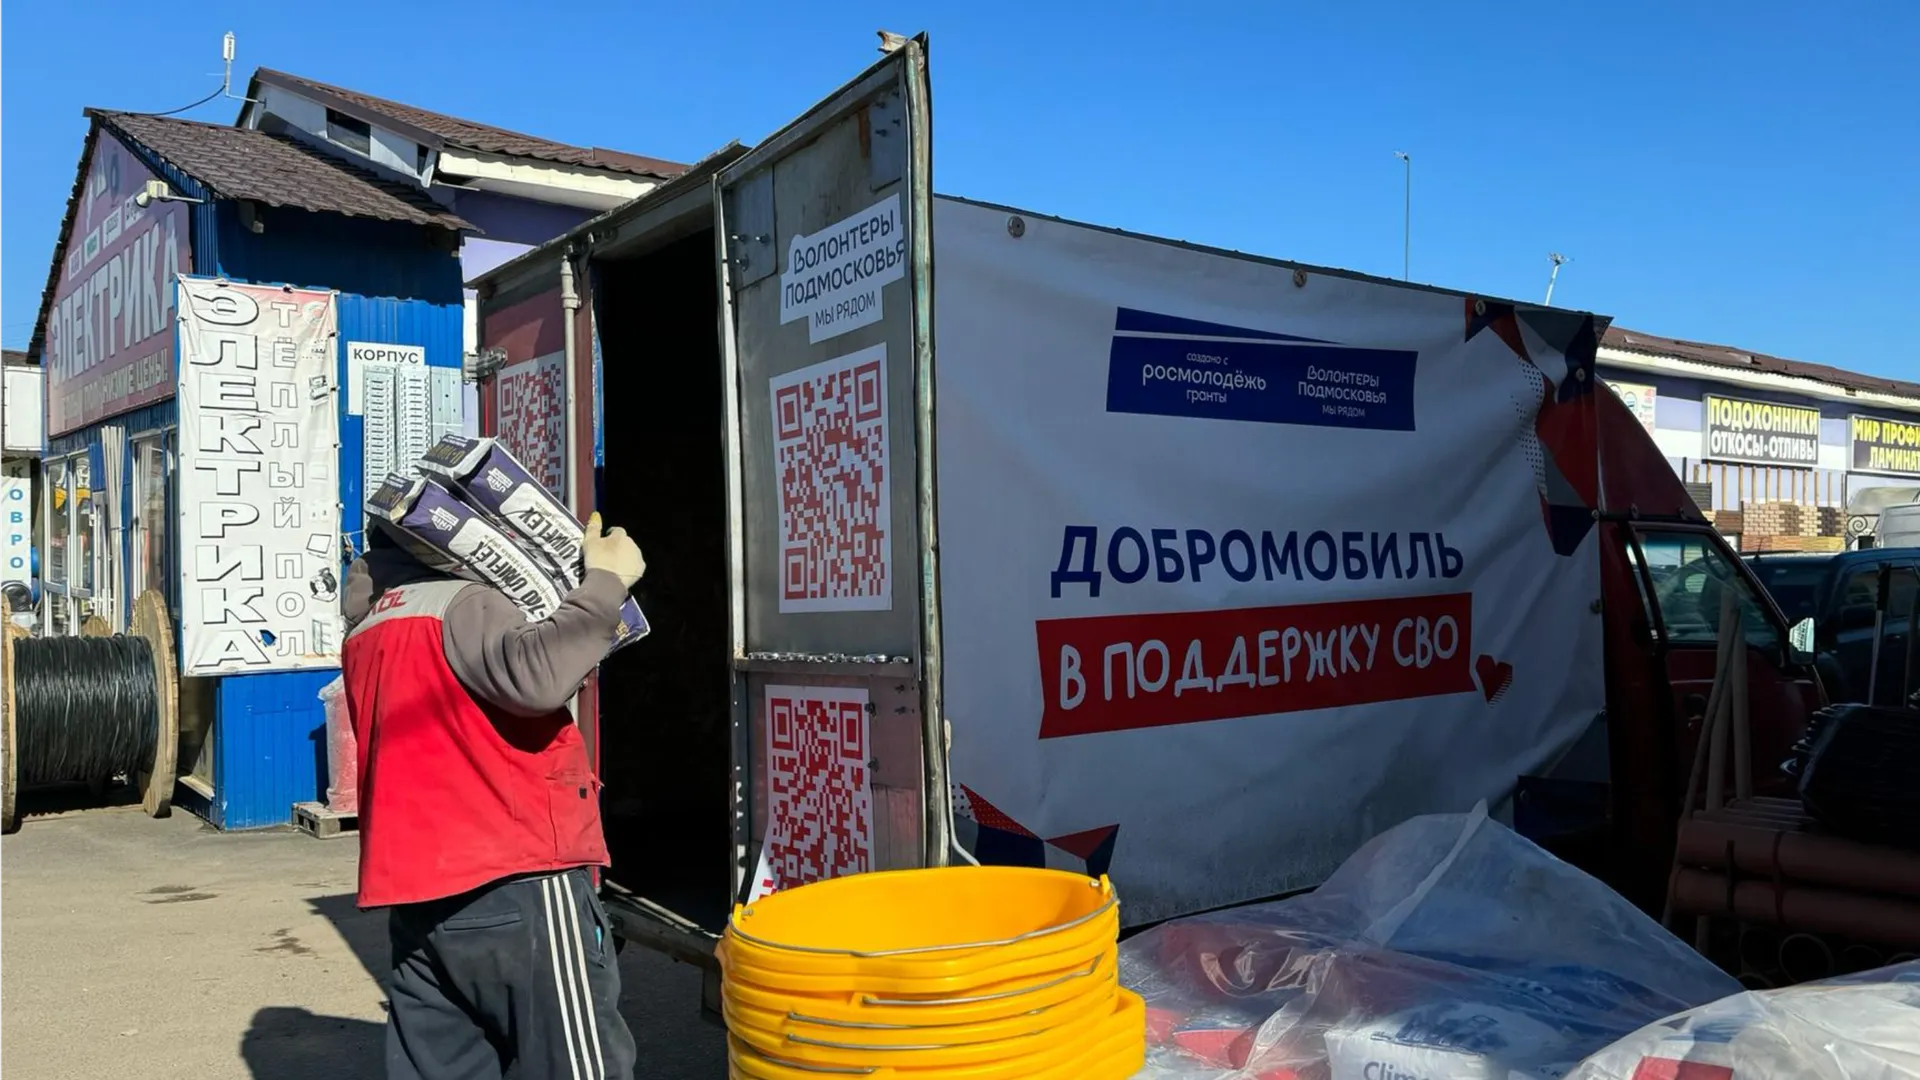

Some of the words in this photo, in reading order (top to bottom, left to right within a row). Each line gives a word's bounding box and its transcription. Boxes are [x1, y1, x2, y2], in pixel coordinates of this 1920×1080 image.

[794, 209, 894, 274] ВОЛОНТЕРЫ
[785, 240, 905, 309] ПОДМОСКОВЬЯ
[51, 211, 178, 389] ЭЛЕКТРИКА
[815, 306, 834, 328] МЫ
[836, 290, 876, 320] РЯДОМ
[353, 348, 419, 364] КОРПУС
[1186, 352, 1222, 365] создано
[1142, 363, 1267, 391] росмолодёжь
[1307, 365, 1380, 387] ВОЛОНТЕРЫ
[1186, 389, 1228, 404] гранты
[1298, 381, 1387, 405] ПОДМОСКОВЬЯ
[1322, 404, 1336, 416] МЫ
[1337, 406, 1366, 418] РЯДОМ
[1709, 399, 1818, 435] ПОДОКОННИКИ
[1853, 419, 1880, 443] МИР
[190, 288, 271, 667] ЭЛЕКТРИКА
[1050, 525, 1464, 598] ДОБРОМОБИЛЬ
[1060, 644, 1086, 711] В
[1104, 623, 1380, 701] ПОДДЕРЖКУ
[1393, 615, 1459, 669] СВО
